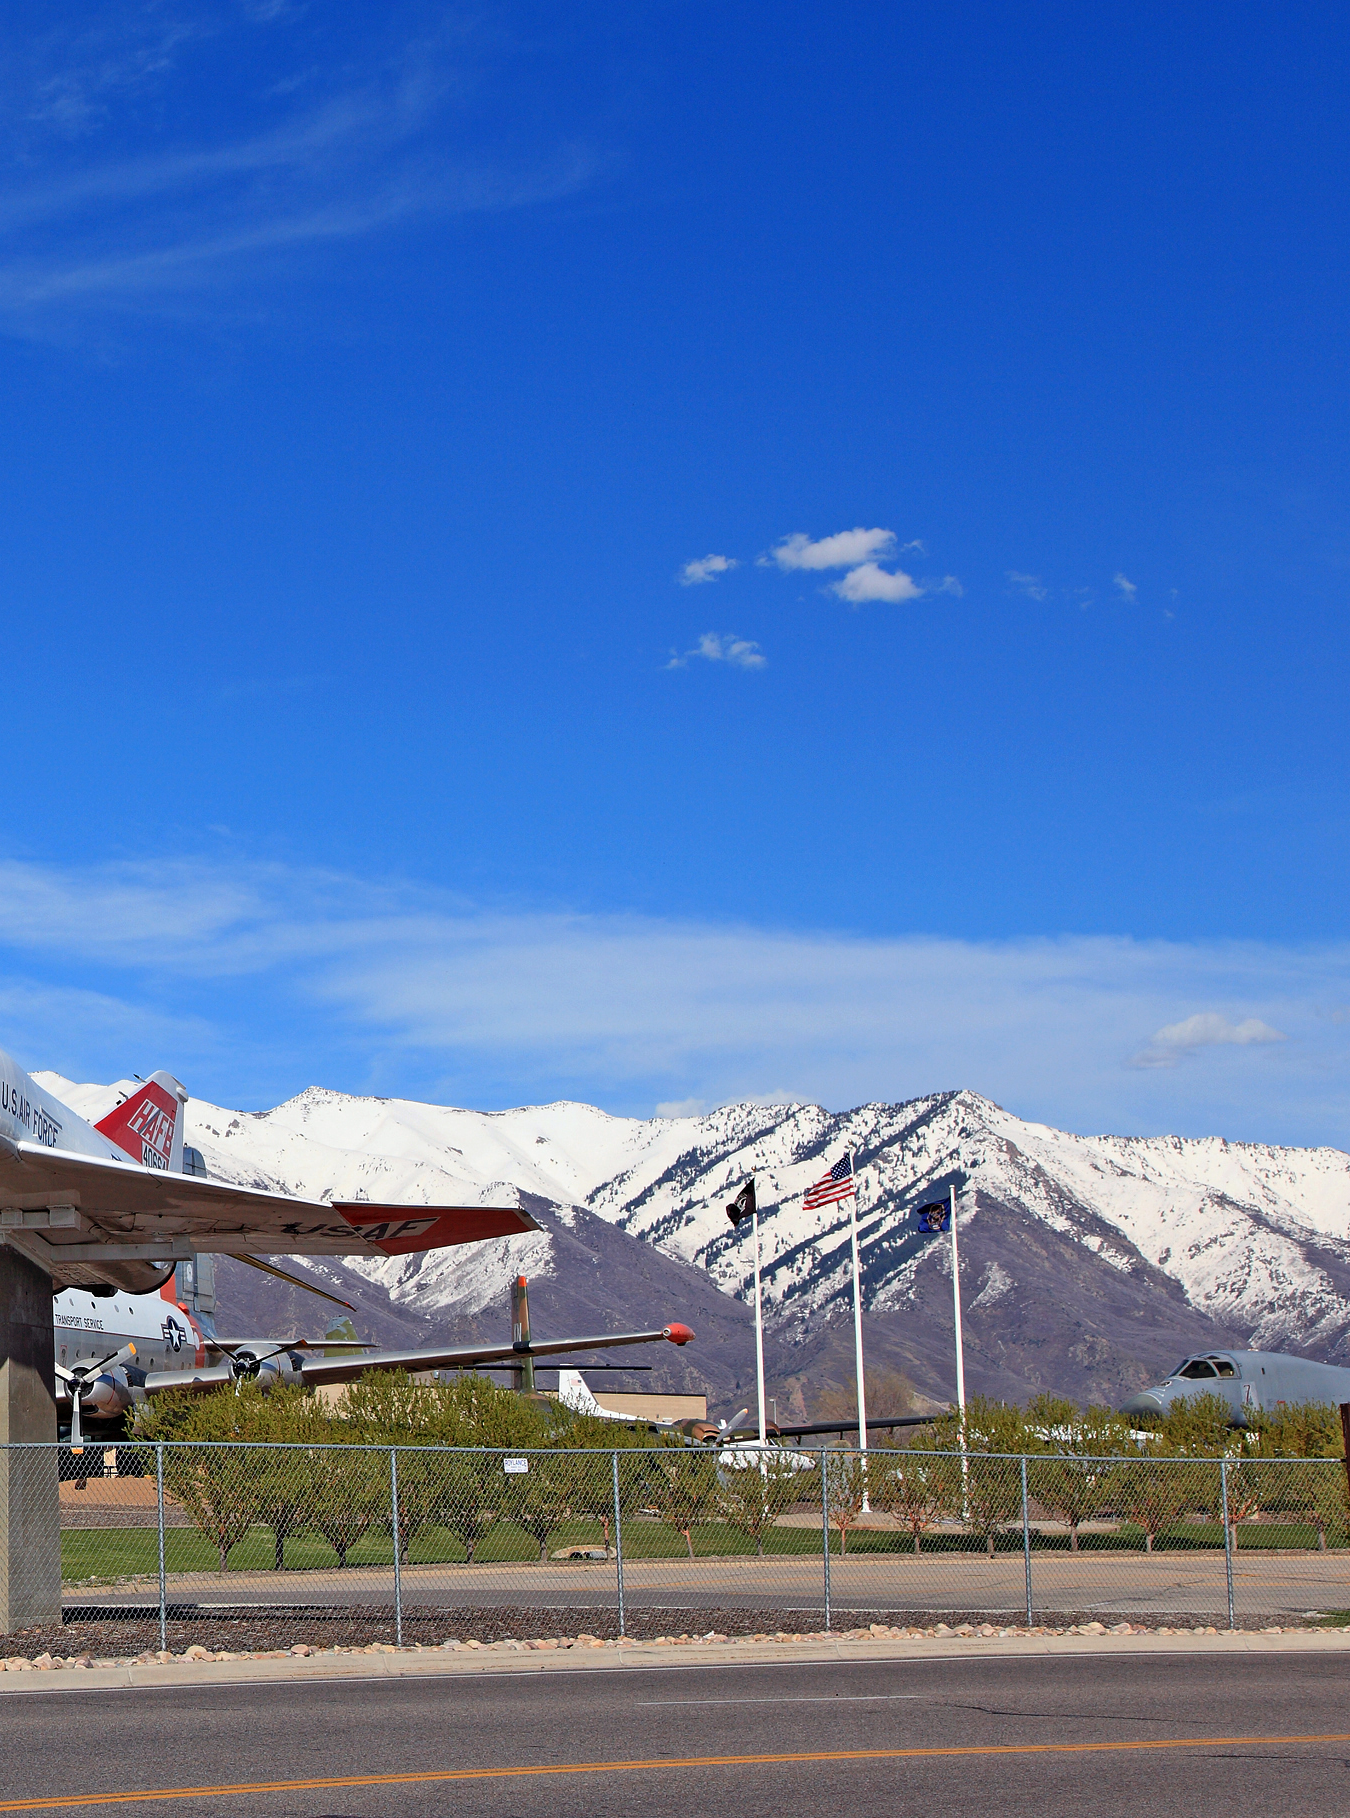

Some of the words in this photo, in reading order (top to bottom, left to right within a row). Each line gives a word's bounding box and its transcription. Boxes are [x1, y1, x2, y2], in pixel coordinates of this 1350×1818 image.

[33, 1109, 59, 1148] FORCE
[128, 1099, 175, 1160] HAFB
[280, 1216, 438, 1242] USAF
[55, 1313, 83, 1328] TRANSPORT
[83, 1317, 104, 1330] SERVICE
